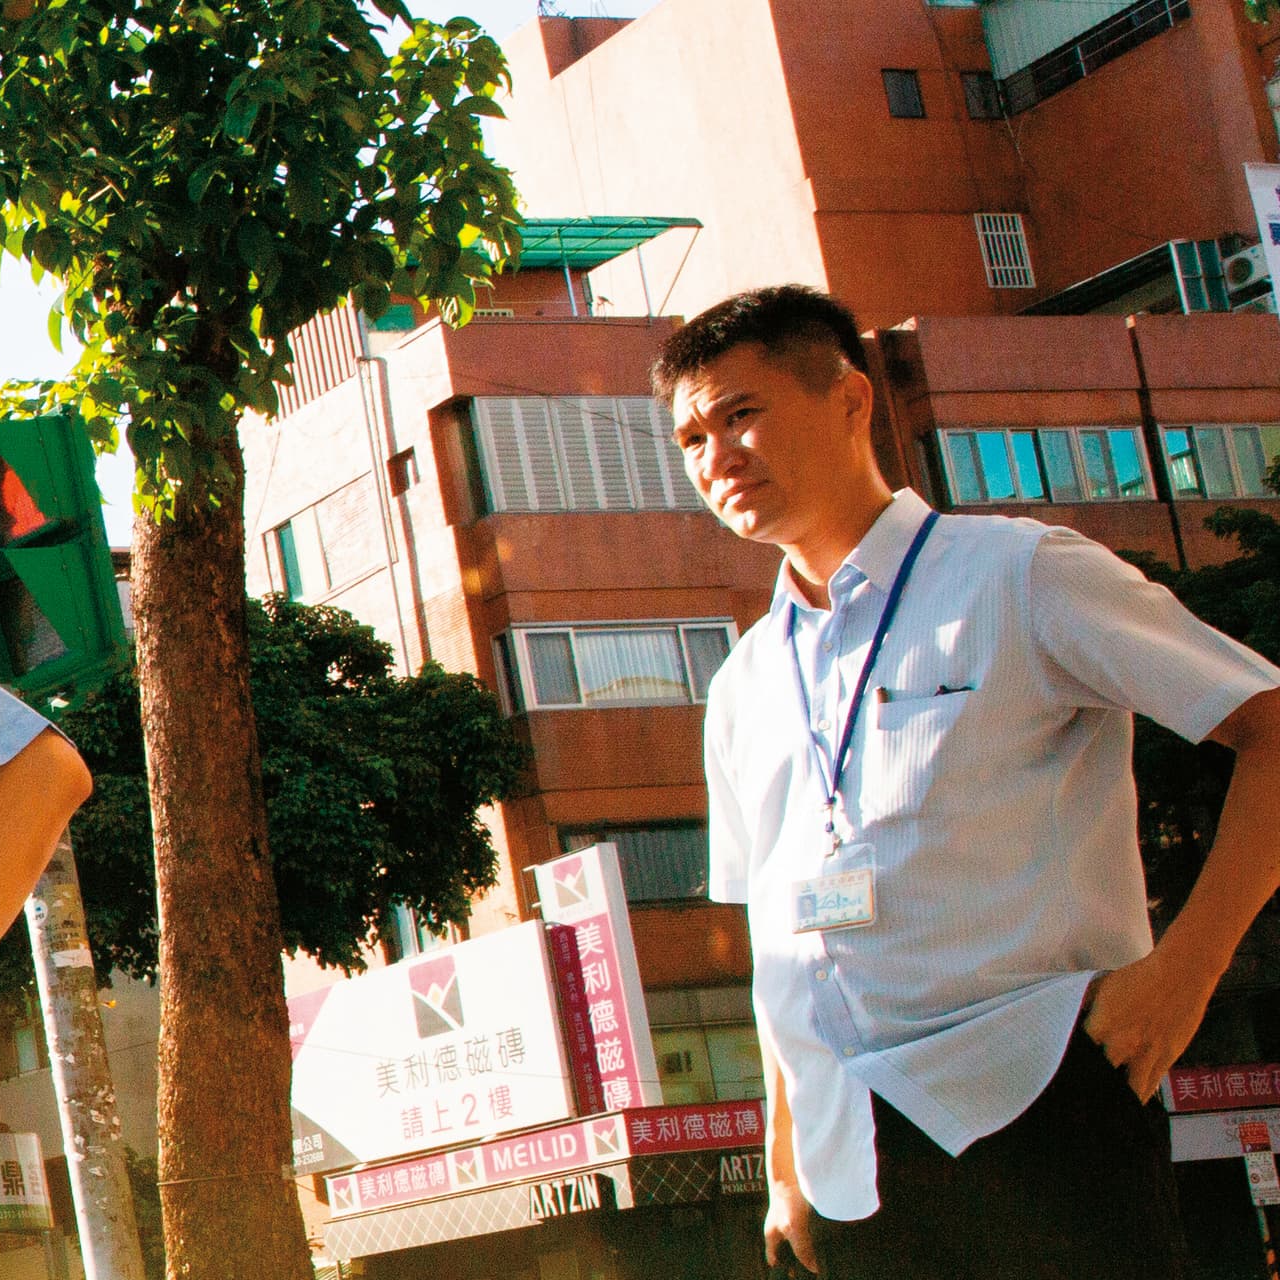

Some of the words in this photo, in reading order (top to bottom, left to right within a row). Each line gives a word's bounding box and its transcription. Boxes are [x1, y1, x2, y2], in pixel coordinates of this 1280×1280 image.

[574, 921, 631, 1112] 美利德磁磚
[375, 1025, 526, 1099] 美利德磁磚
[399, 1084, 514, 1140] 請上2樓
[631, 1109, 759, 1145] 美利德磁磚
[491, 1132, 577, 1173] MEILID
[359, 1160, 446, 1201] 美利德磁磚
[529, 1173, 601, 1220] ARTZIN
